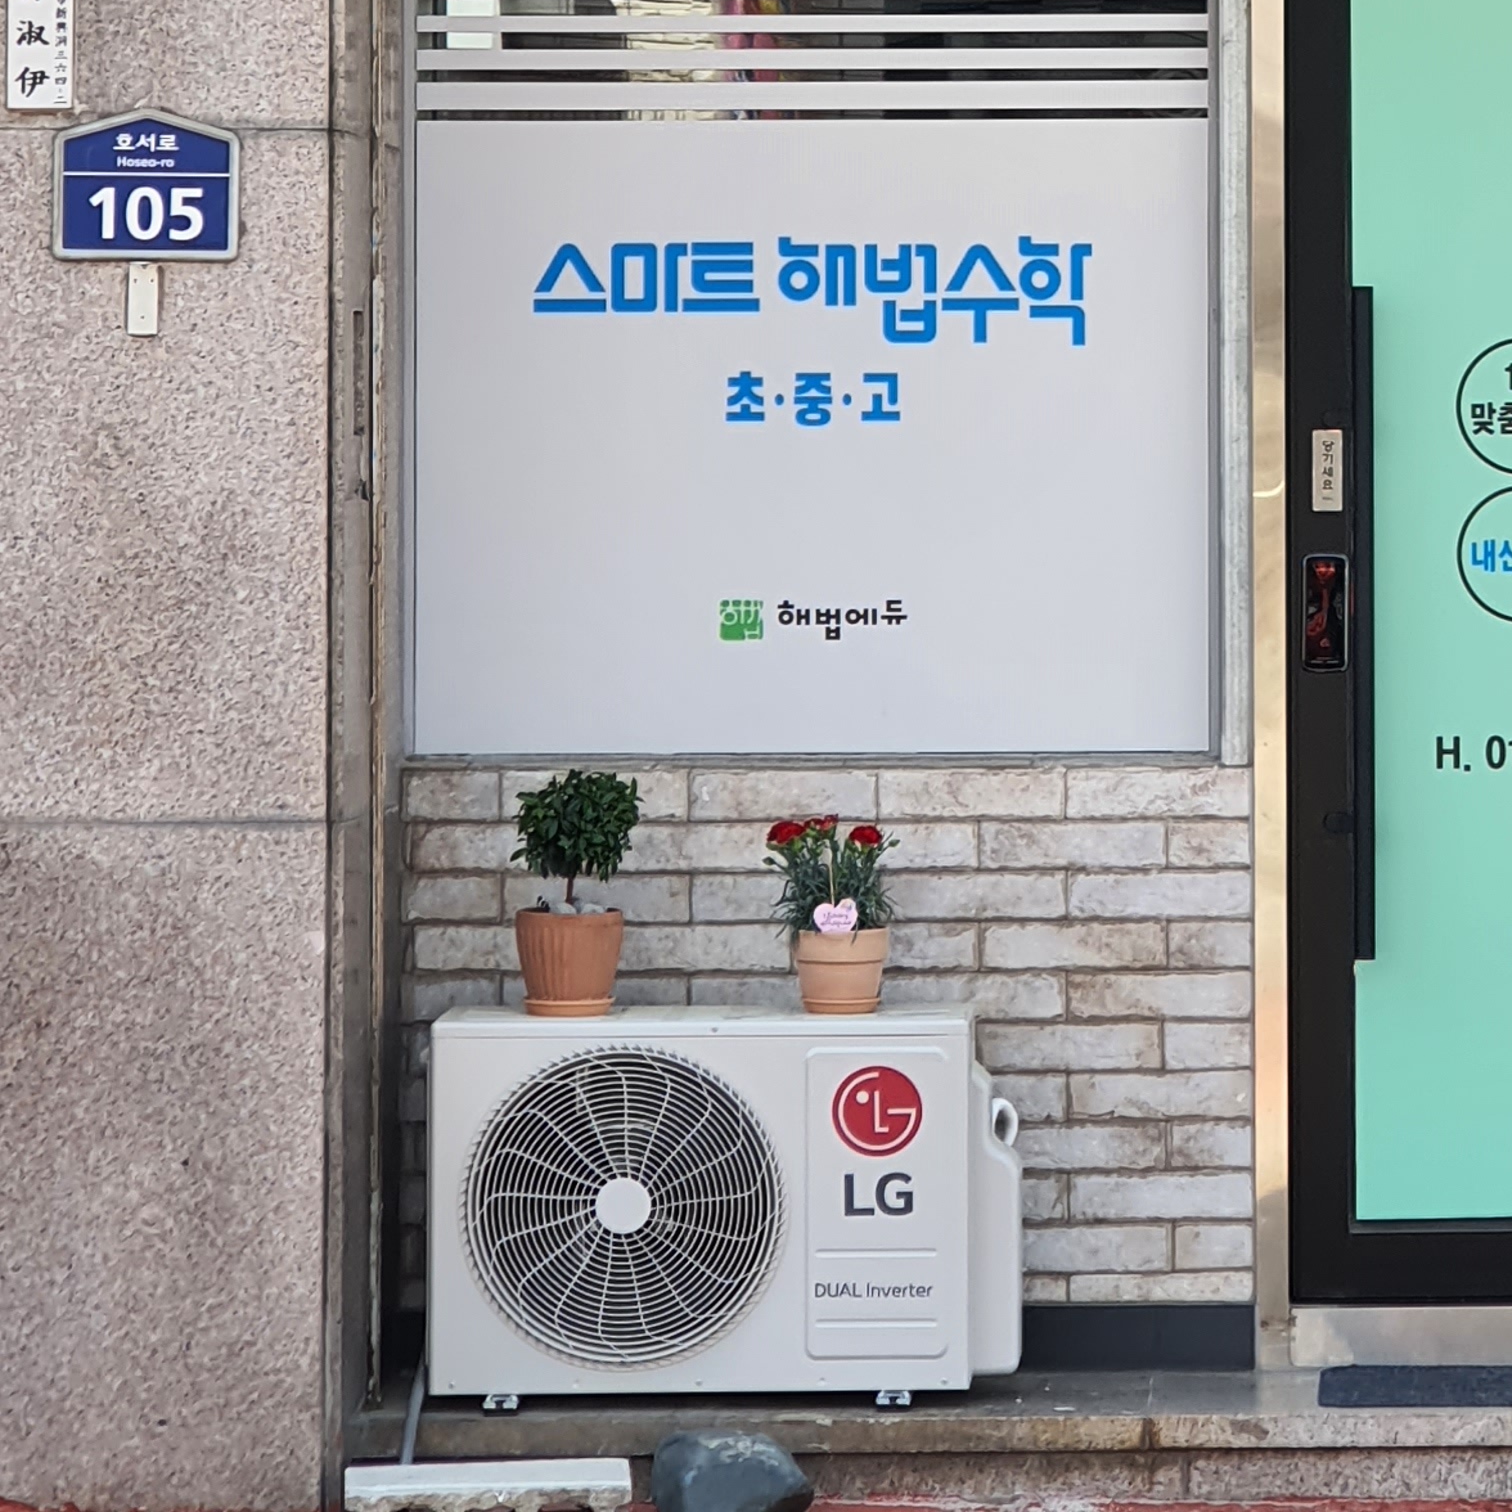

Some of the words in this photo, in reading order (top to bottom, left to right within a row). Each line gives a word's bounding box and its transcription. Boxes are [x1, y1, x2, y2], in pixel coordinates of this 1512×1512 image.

[113, 133, 179, 153] 호서로
[117, 156, 175, 168] Hoseo-ro
[88, 186, 204, 241] 105
[533, 242, 760, 312] 스마트
[778, 236, 1092, 346] 해법수학
[777, 599, 908, 641] 해법에듀
[1435, 736, 1471, 772] H.
[843, 1172, 914, 1217] LG
[814, 1282, 863, 1298] DUAL
[866, 1281, 934, 1298] Inverter
